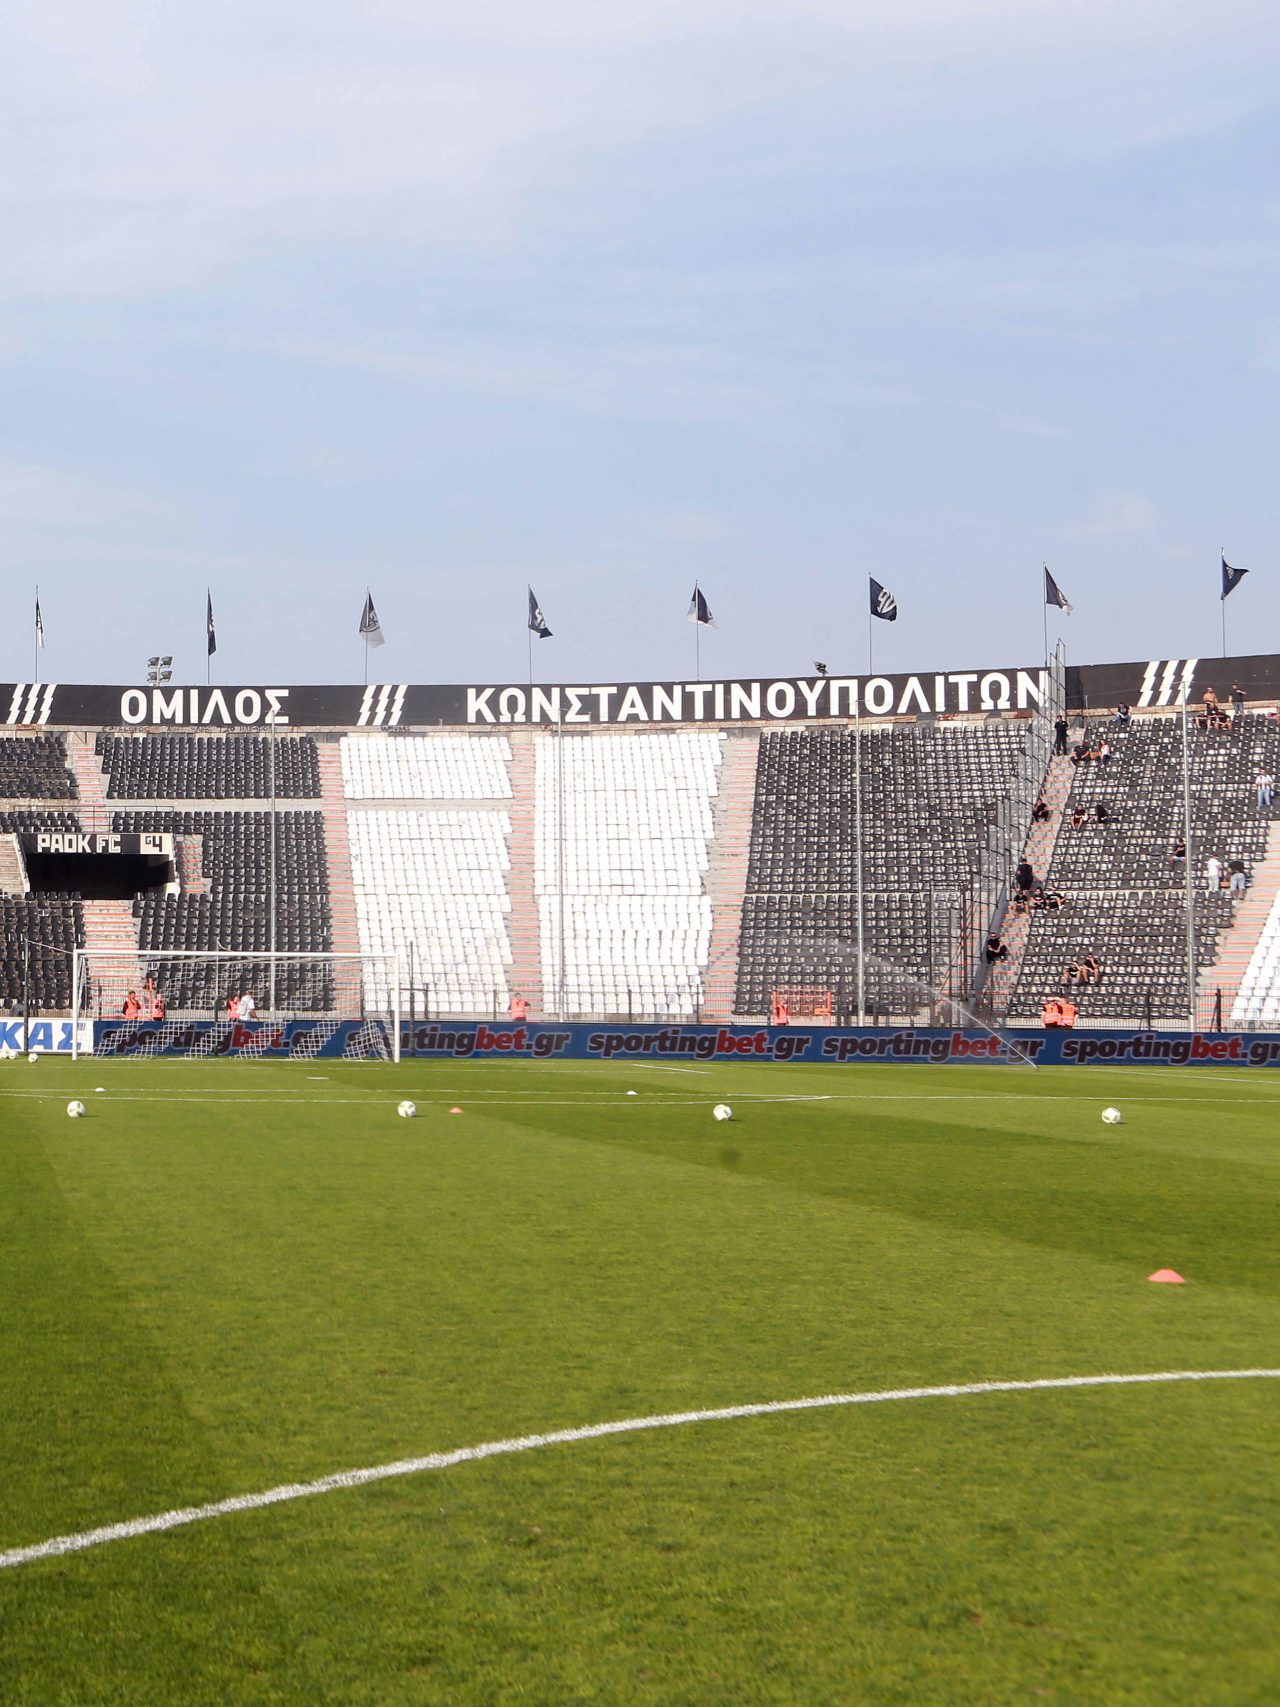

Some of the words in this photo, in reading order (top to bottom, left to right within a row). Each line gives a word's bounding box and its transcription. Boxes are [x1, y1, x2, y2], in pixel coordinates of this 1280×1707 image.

[120, 688, 290, 725] ΟΜΙΛΟΣ
[466, 669, 1050, 724] ΚΩΝΣΤΑΝΤΙΝΟΥΠΟΛΙΤΩΝ
[37, 833, 92, 853] PAOK
[96, 833, 122, 853] FC
[588, 1028, 811, 1060] sportingbet.gr
[821, 1031, 1044, 1063] sportingbet.gr
